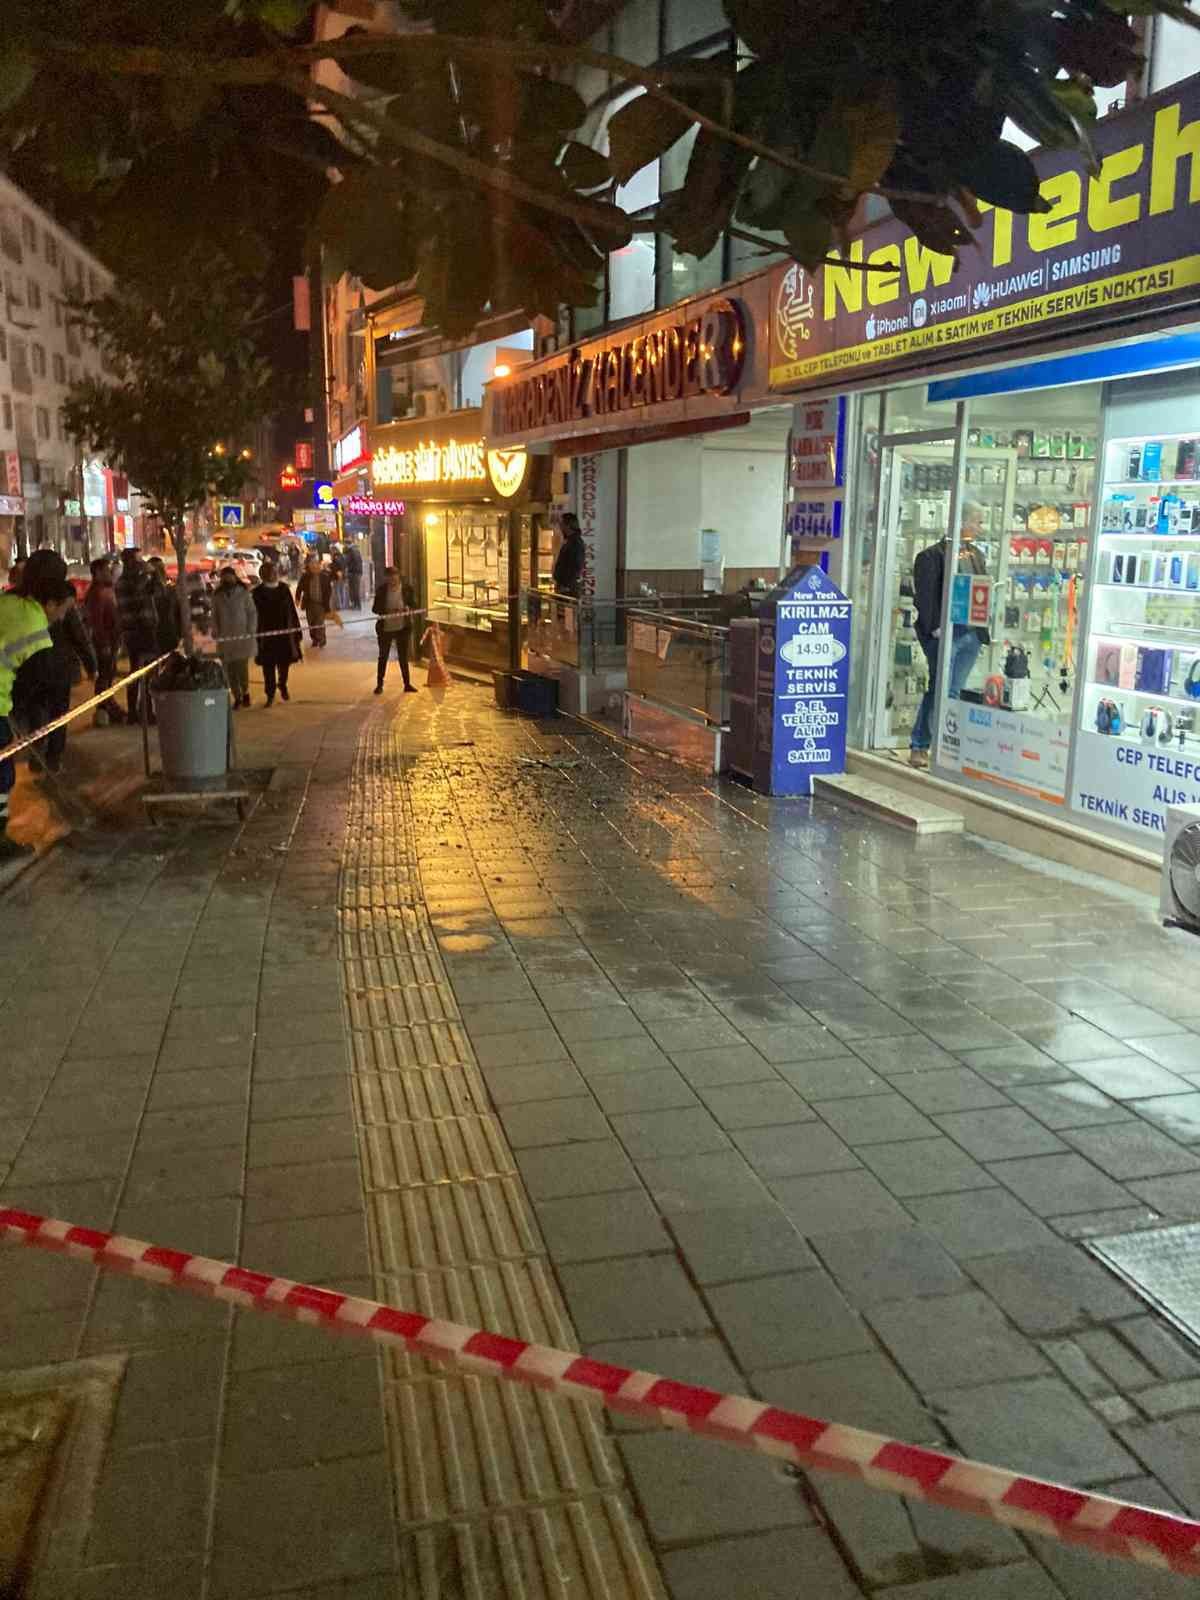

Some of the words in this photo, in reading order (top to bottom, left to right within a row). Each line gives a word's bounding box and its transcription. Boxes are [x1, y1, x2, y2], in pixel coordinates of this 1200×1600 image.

[991, 269, 1043, 299] HUAWEI
[1052, 243, 1121, 281] SAMSUNG
[873, 340, 908, 358] TABLET
[909, 332, 934, 347] ALIM
[945, 321, 980, 341] SATIM
[996, 300, 1043, 328] TEKNİK
[1047, 285, 1098, 314] SERVİS
[1103, 268, 1175, 300] NOKTASI
[781, 606, 849, 619] KIRILMAZ
[799, 622, 830, 635] CAM
[796, 642, 830, 656] 14.90
[786, 666, 839, 681] TEKNİK
[787, 681, 837, 695] SERVİS
[809, 700, 827, 713] EL
[783, 712, 838, 727] TELEFON
[794, 726, 826, 738] ALIM
[788, 749, 830, 763] SATIMI
[1116, 746, 1144, 766] CEP
[1079, 793, 1129, 821] TEKNİK
